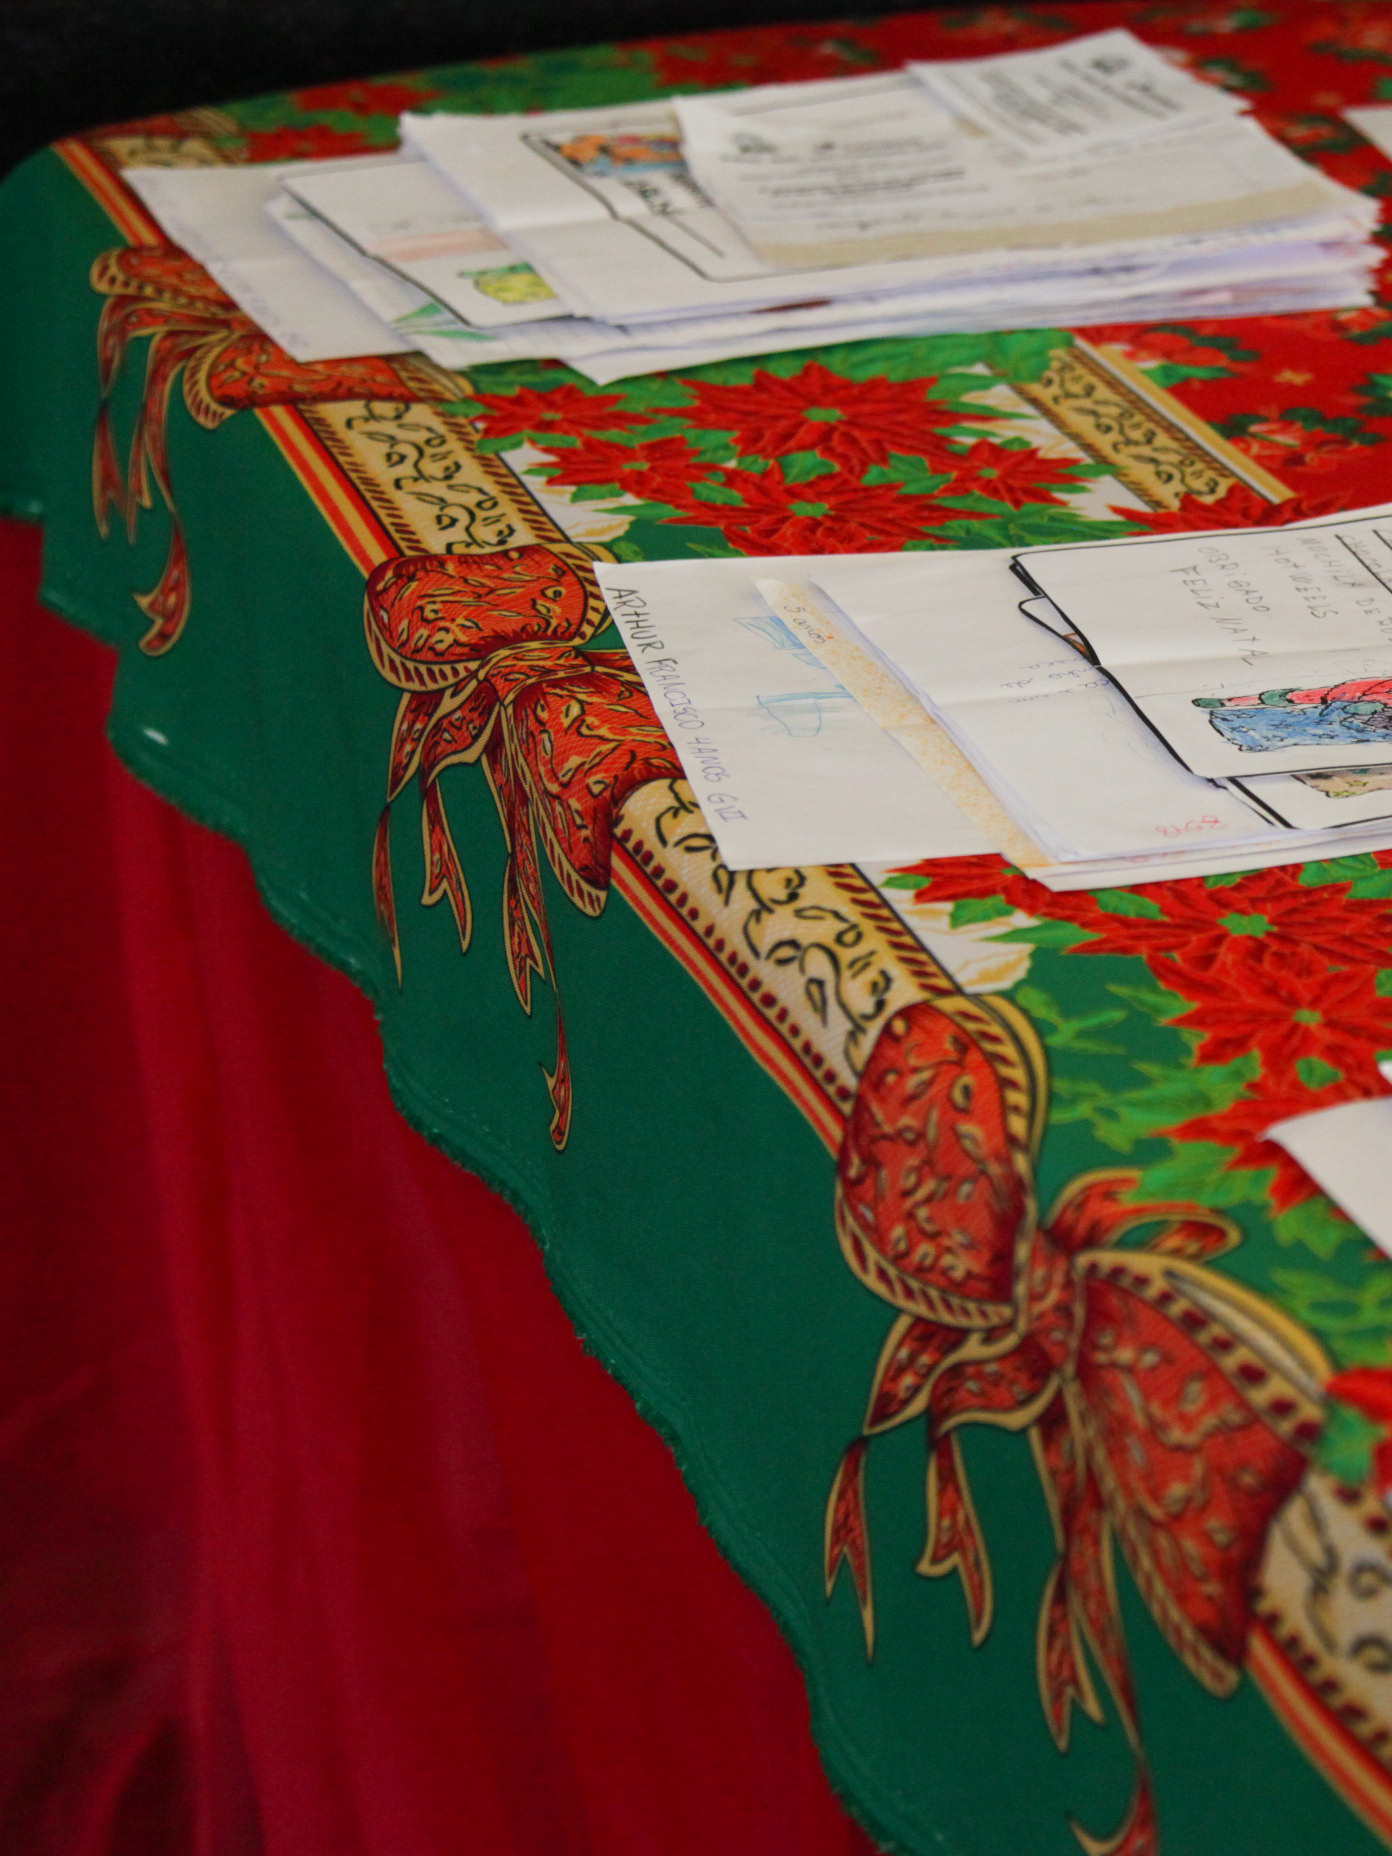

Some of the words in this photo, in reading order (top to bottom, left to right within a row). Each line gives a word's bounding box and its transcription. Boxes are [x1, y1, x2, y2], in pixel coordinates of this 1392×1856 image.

[604, 586, 665, 654] ARTHUR
[645, 657, 705, 730] FRANCISCO
[1211, 616, 1271, 667] NATAL
